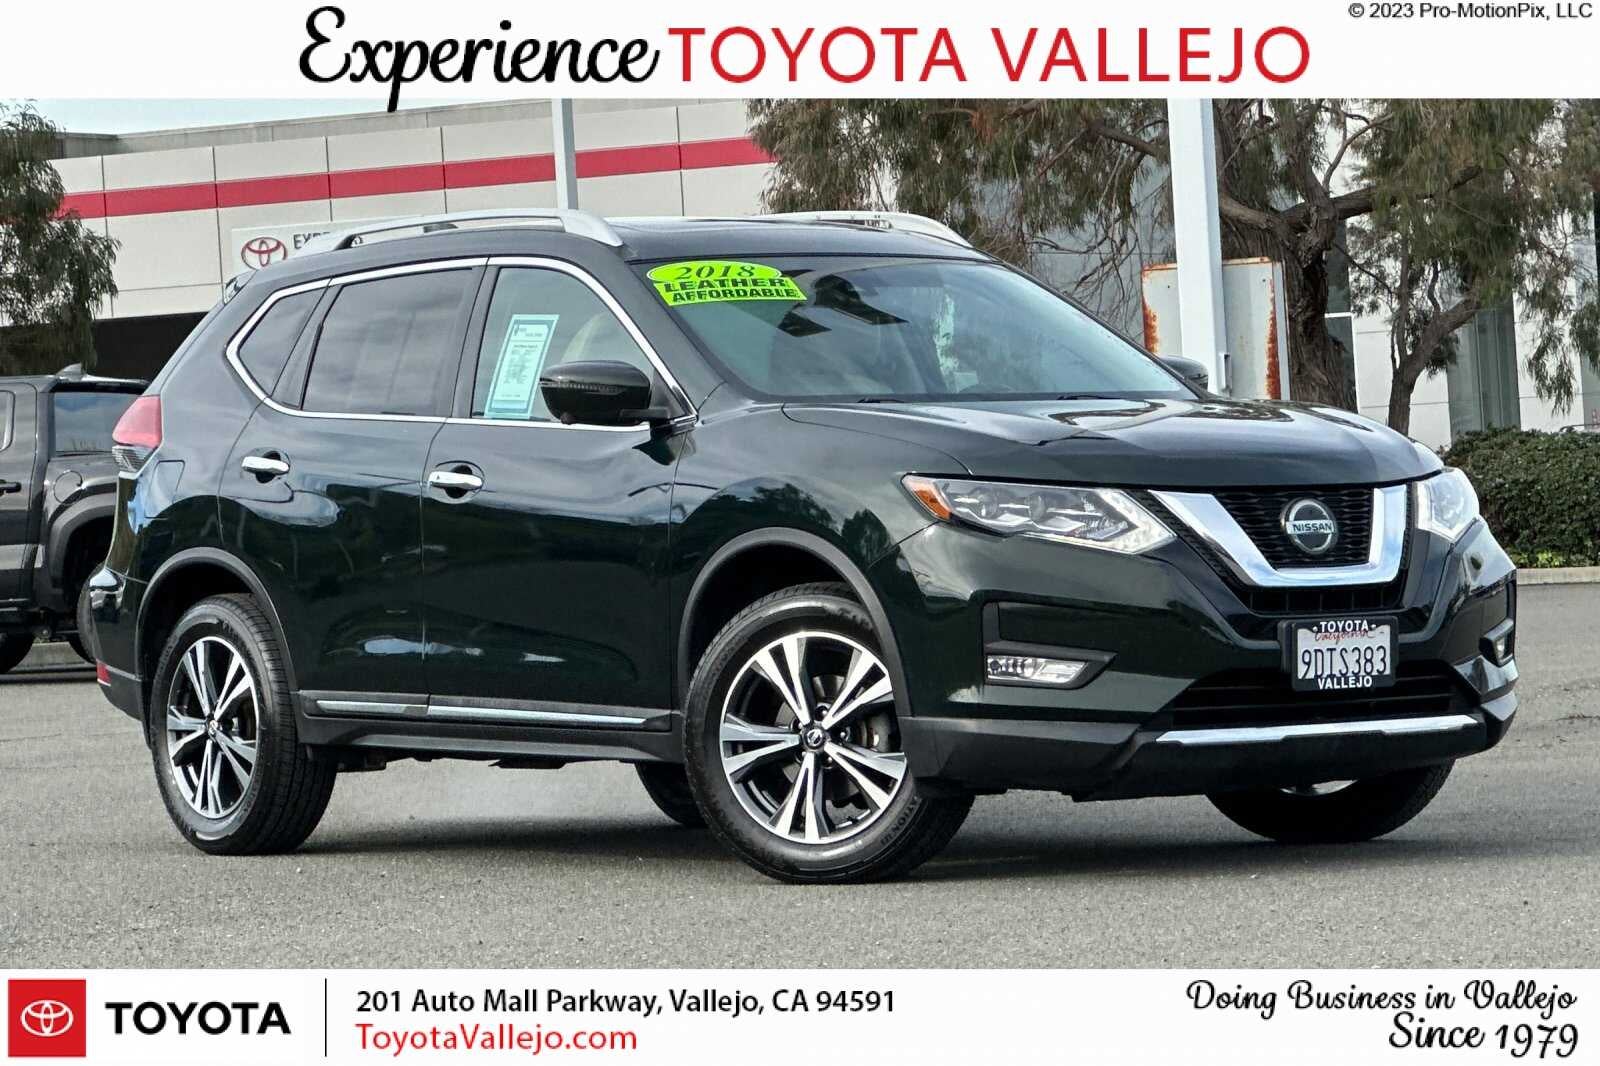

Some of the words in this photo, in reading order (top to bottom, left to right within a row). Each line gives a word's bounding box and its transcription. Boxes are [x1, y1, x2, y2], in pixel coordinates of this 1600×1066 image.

[674, 264, 757, 281] 2018
[663, 277, 787, 293] LEATHER
[672, 287, 798, 303] AFFORDABLE
[1291, 522, 1333, 534] NISSAN
[1319, 619, 1369, 633] TOYOTA
[1317, 675, 1373, 690] VALLEJO
